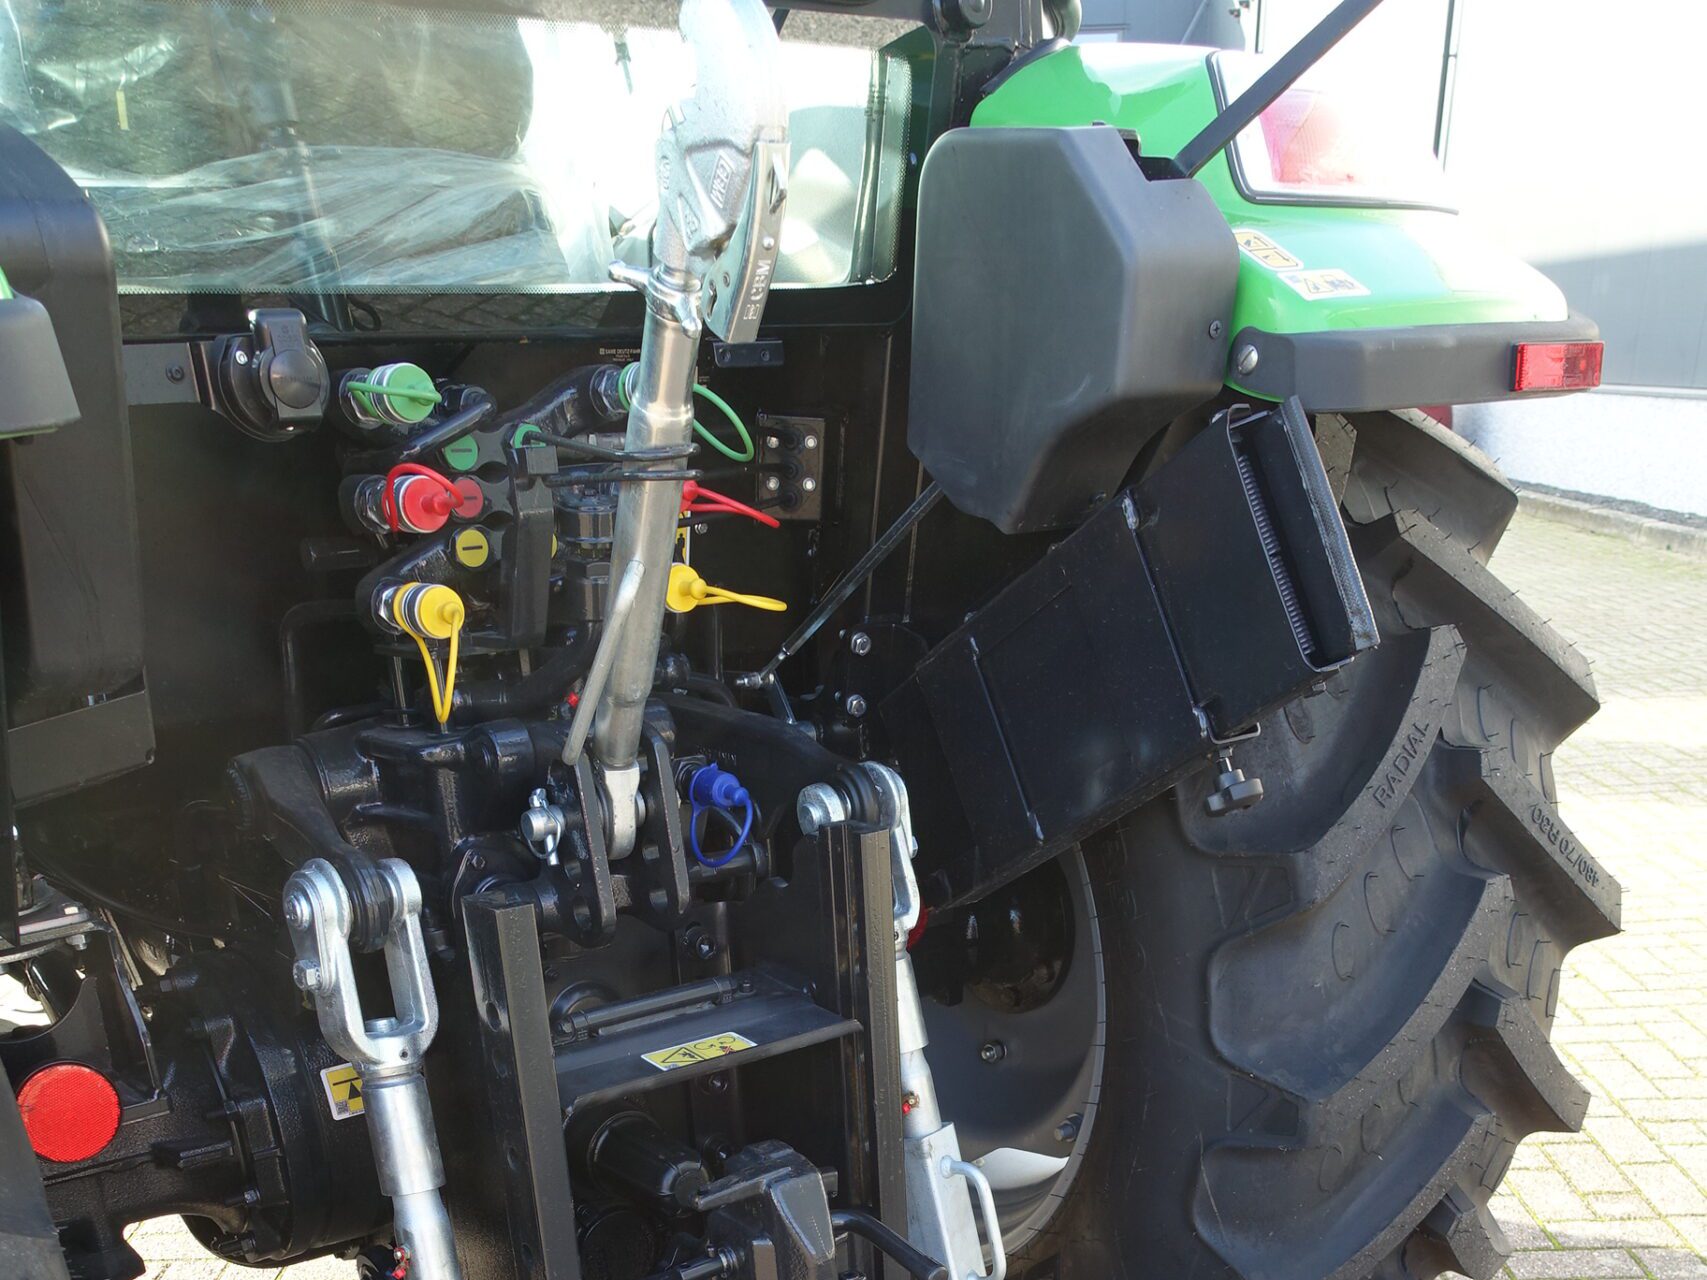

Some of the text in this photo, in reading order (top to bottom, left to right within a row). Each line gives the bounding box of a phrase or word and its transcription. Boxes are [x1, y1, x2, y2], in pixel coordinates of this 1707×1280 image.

[750, 259, 772, 301] CBM
[1372, 721, 1430, 808] RADIAL
[1558, 837, 1600, 888] 480/70
